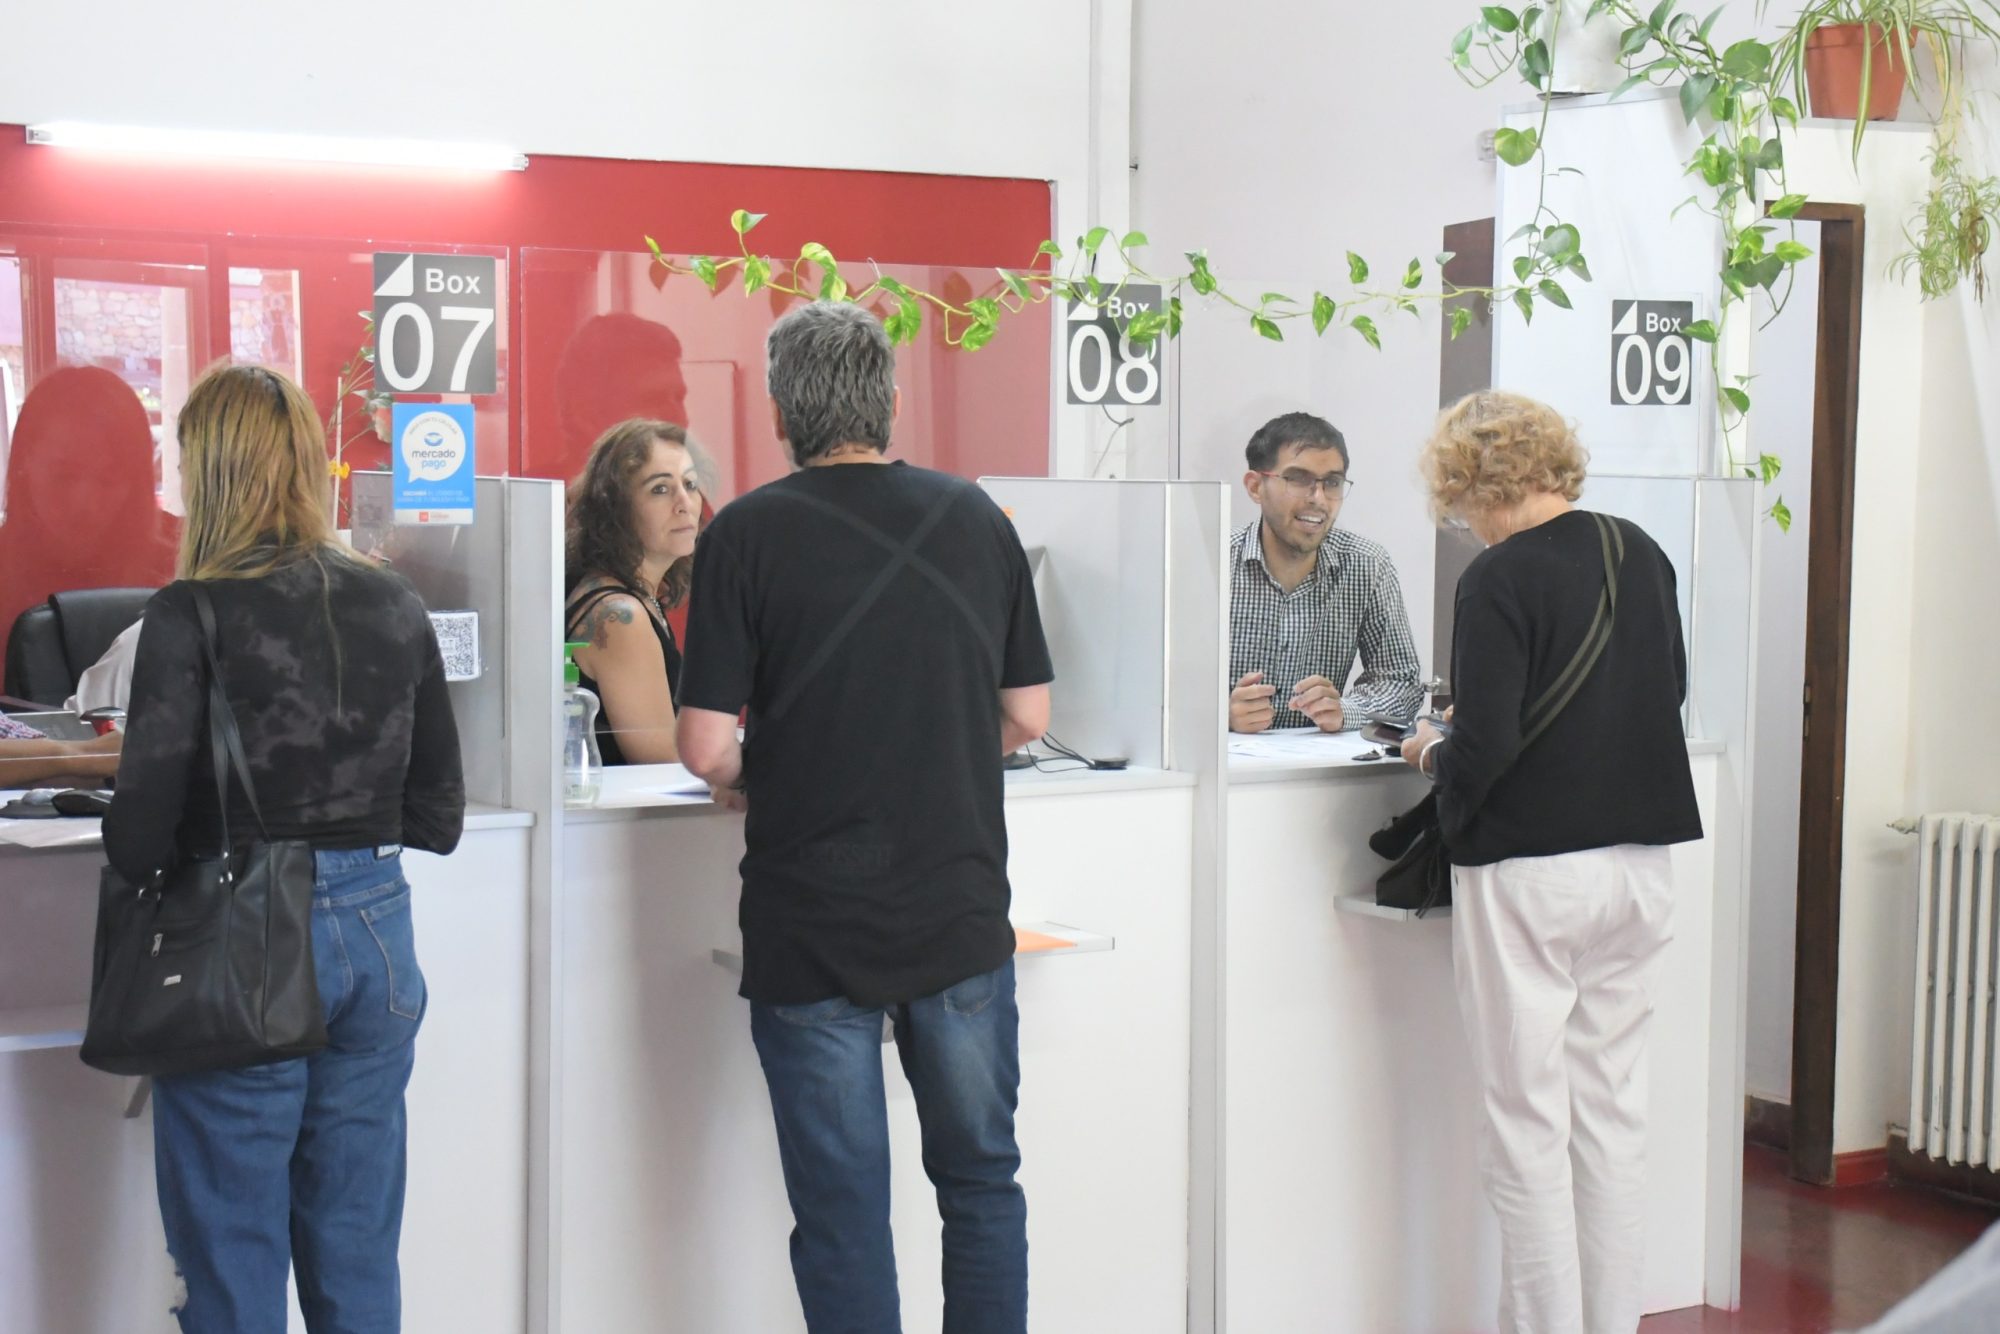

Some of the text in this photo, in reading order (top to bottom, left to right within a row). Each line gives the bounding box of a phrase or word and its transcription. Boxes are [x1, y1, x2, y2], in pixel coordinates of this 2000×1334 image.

[424, 268, 481, 294] Box
[1646, 312, 1682, 333] Box
[378, 302, 495, 392] 07
[1069, 324, 1158, 404] 08
[1616, 334, 1690, 405] 09
[411, 449, 456, 458] mercado
[421, 459, 447, 470] pago
